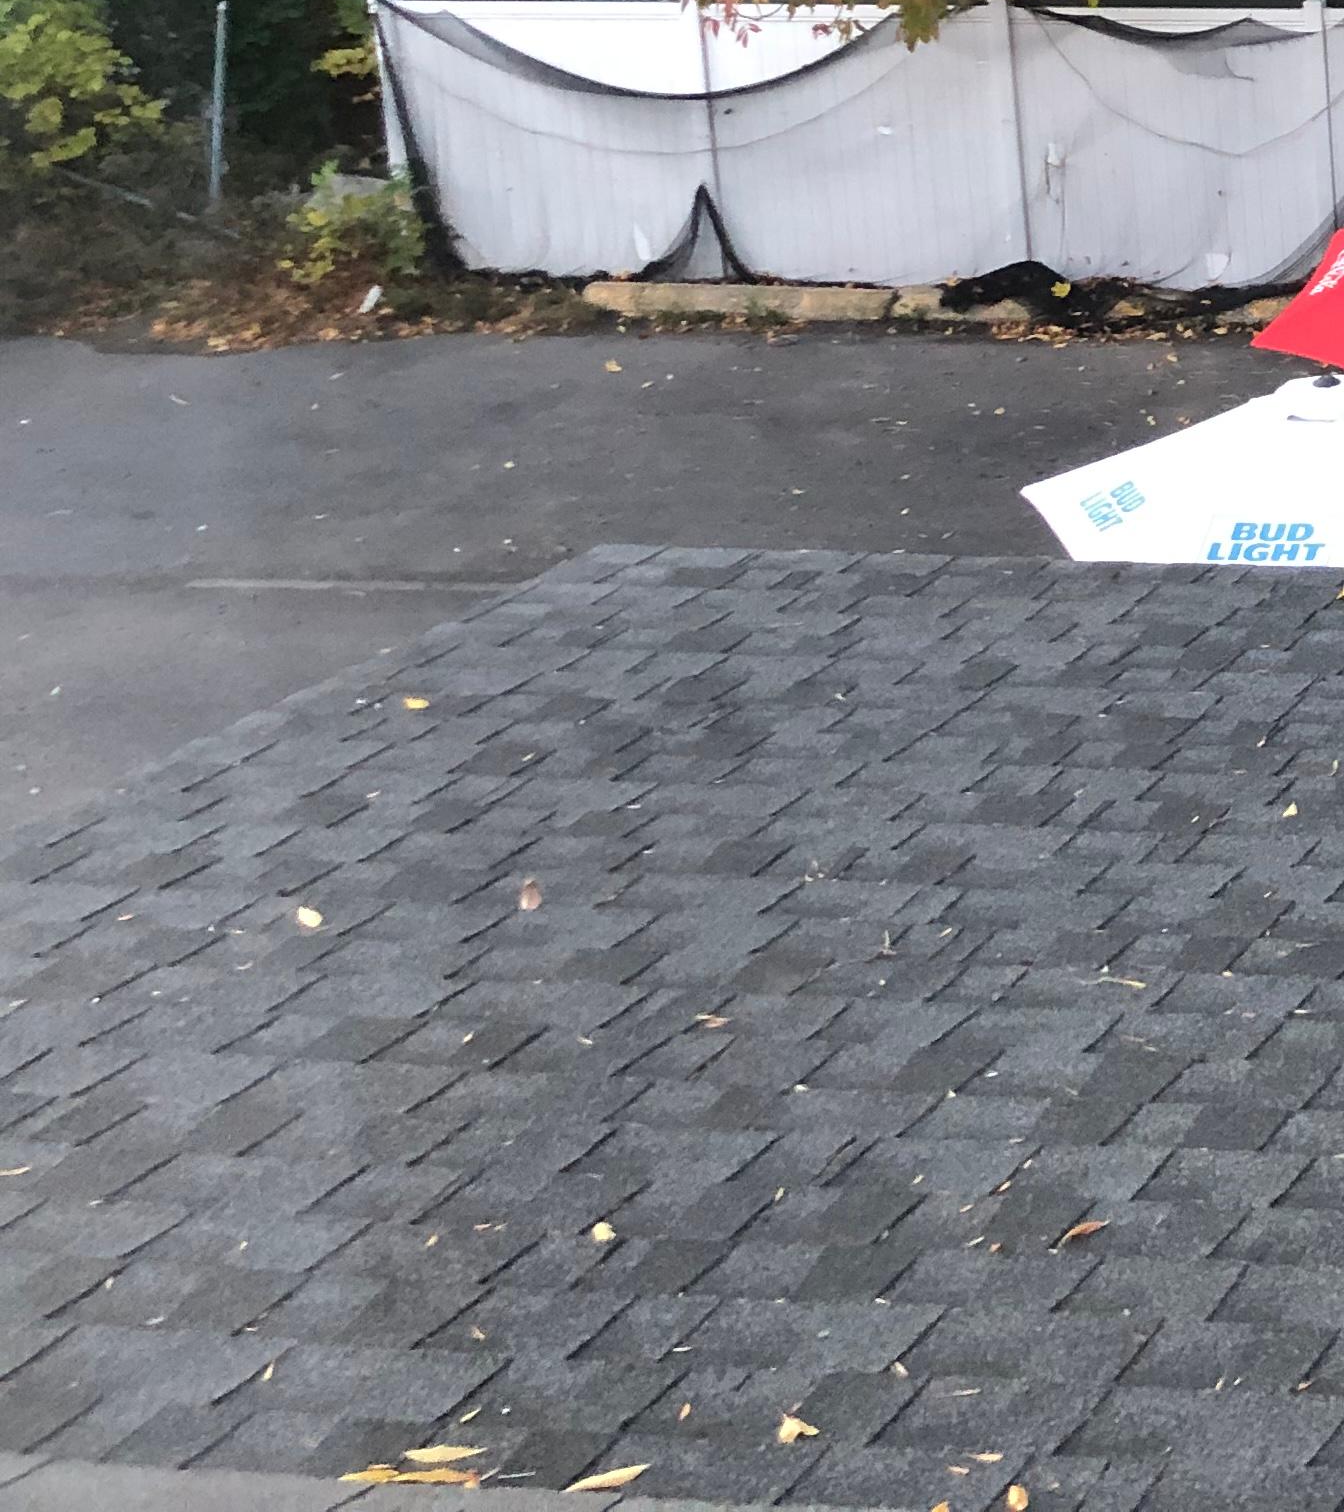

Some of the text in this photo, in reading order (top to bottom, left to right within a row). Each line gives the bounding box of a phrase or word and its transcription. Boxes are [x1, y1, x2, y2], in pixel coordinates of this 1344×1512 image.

[1109, 480, 1146, 513] BUD
[1080, 490, 1124, 532] LIGHT
[1230, 522, 1315, 542] BUD
[1206, 542, 1326, 562] LIGHT
